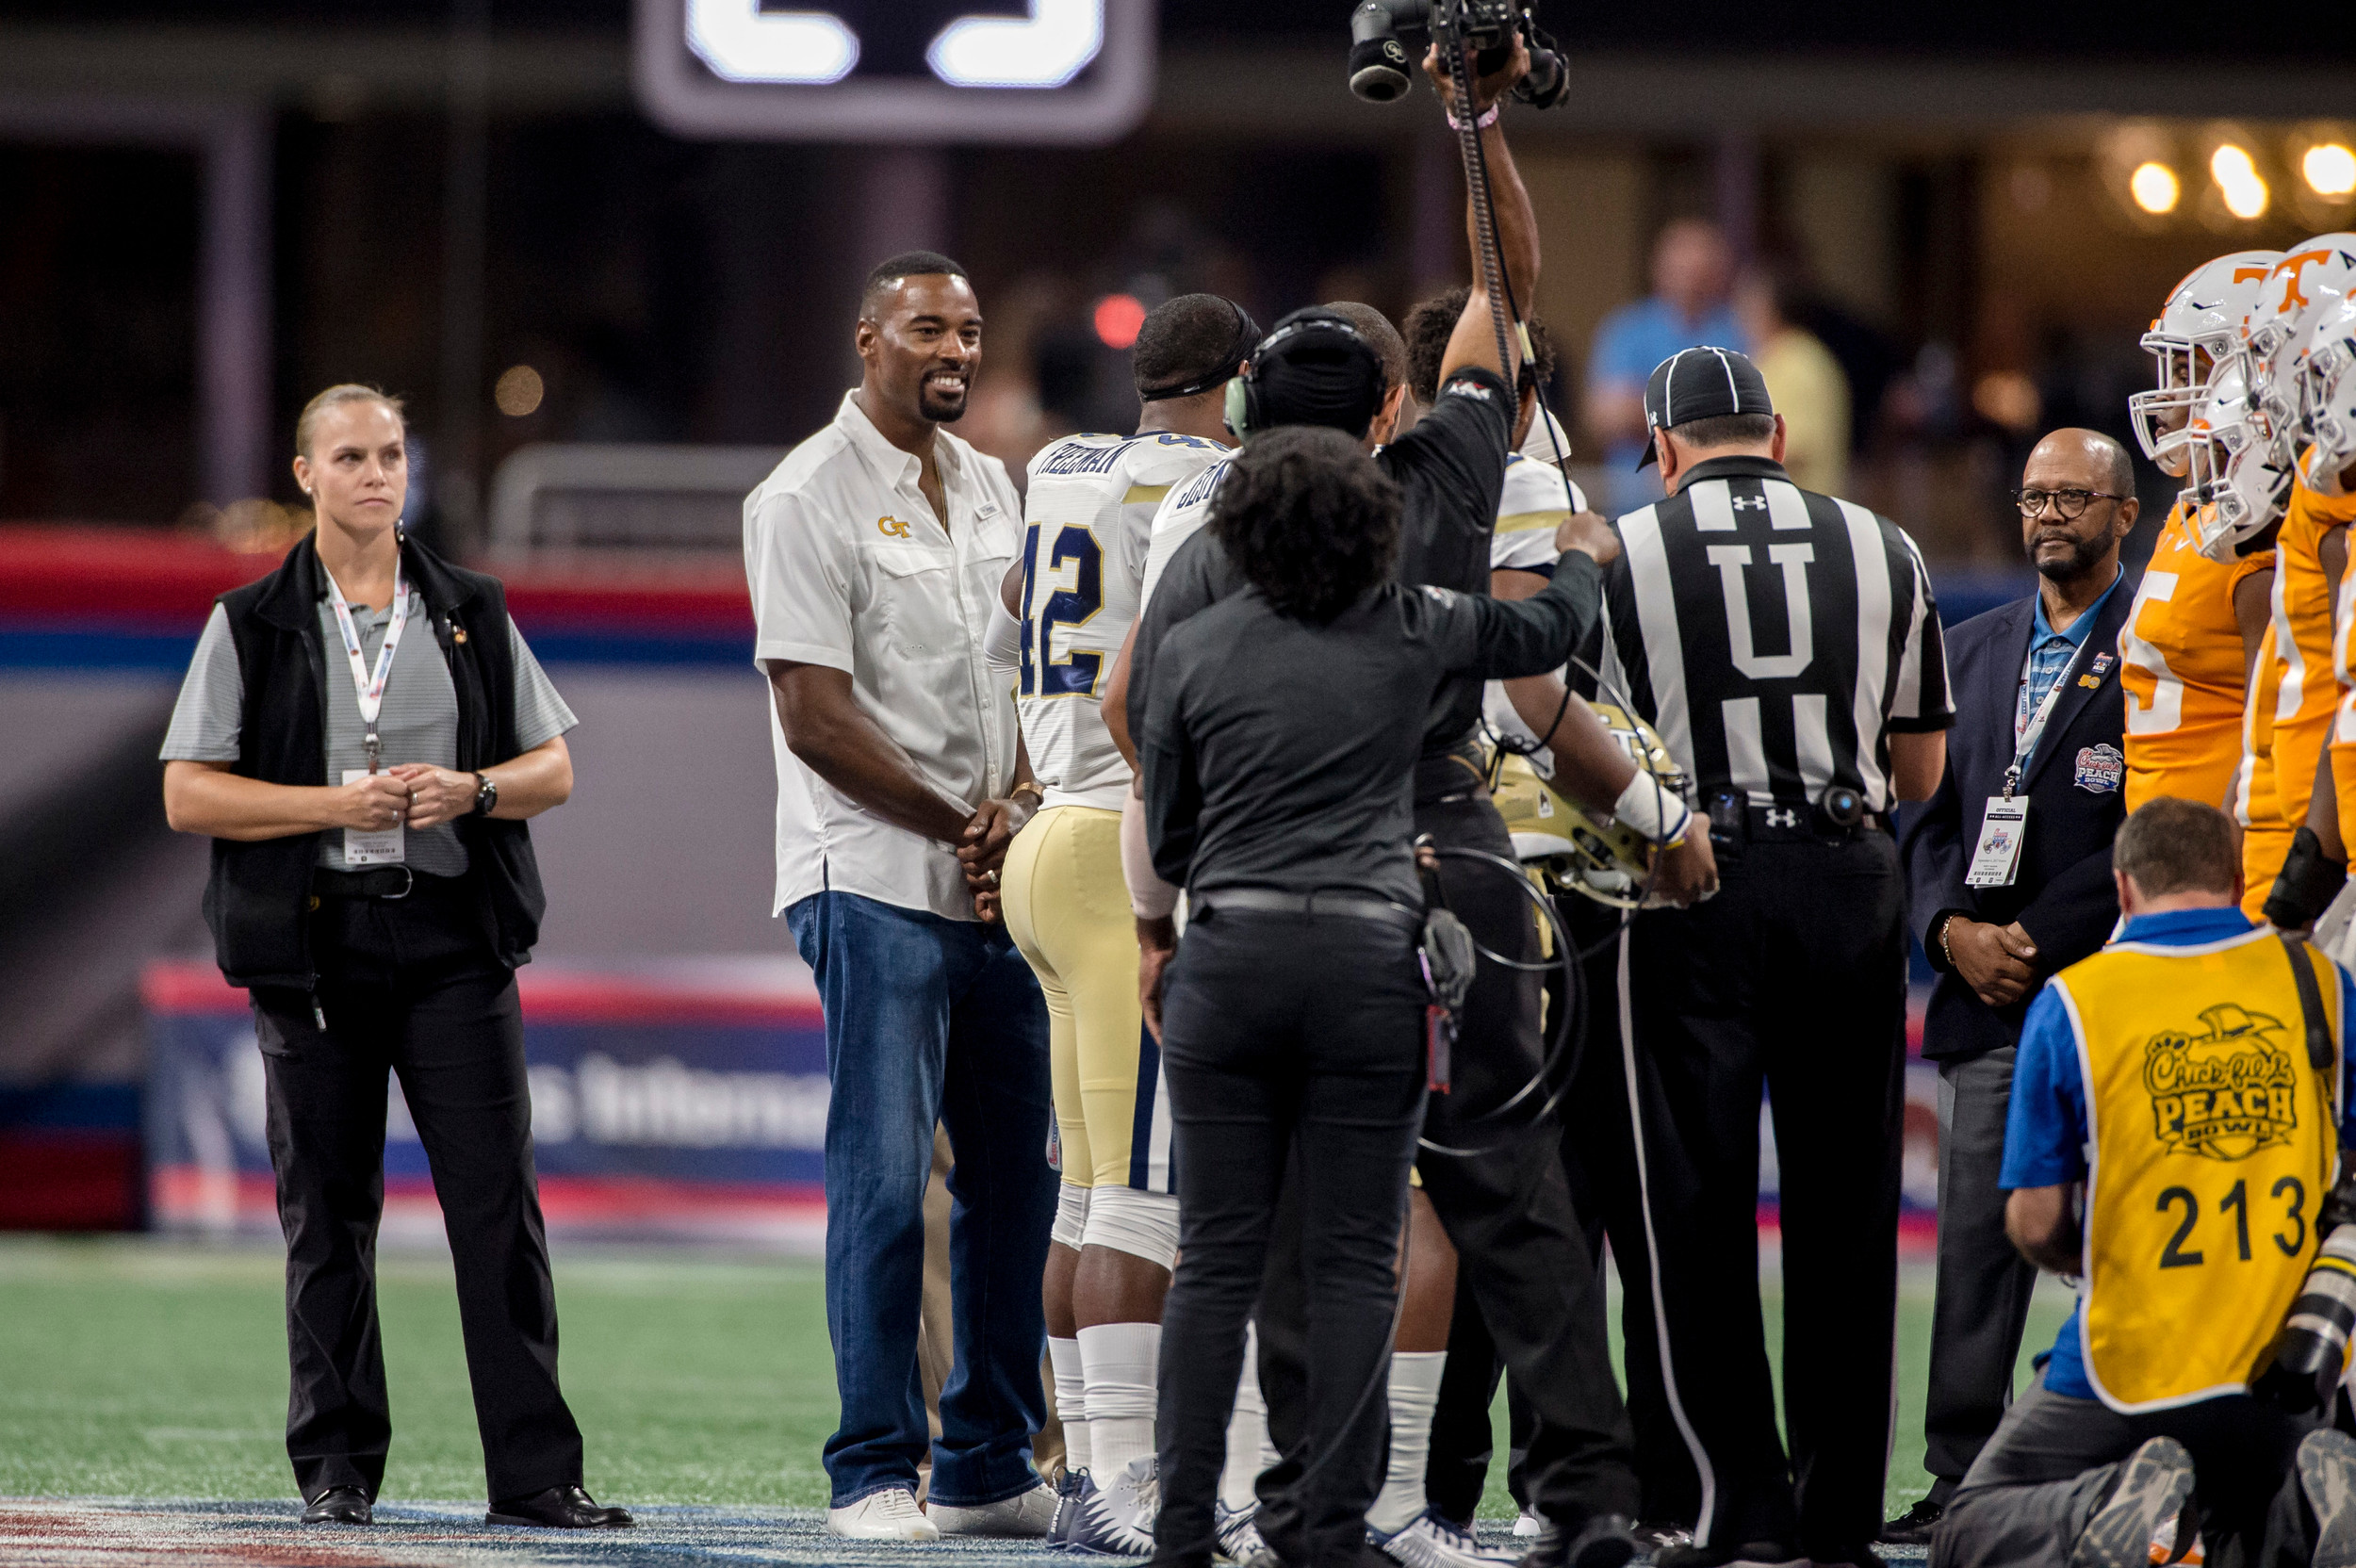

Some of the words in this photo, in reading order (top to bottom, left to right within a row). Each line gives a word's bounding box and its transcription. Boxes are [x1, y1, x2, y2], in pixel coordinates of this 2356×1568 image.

[2271, 249, 2333, 314] T
[1035, 441, 1140, 476] FREEMAN
[1176, 458, 1235, 510] JEUN
[877, 514, 912, 540] GT
[1706, 542, 1816, 680] U
[2117, 569, 2184, 736] 5
[2077, 767, 2119, 783] PEACH
[2153, 1086, 2296, 1140] PEACH
[2185, 1119, 2270, 1142] BOWL
[2154, 1175, 2306, 1270] 213
